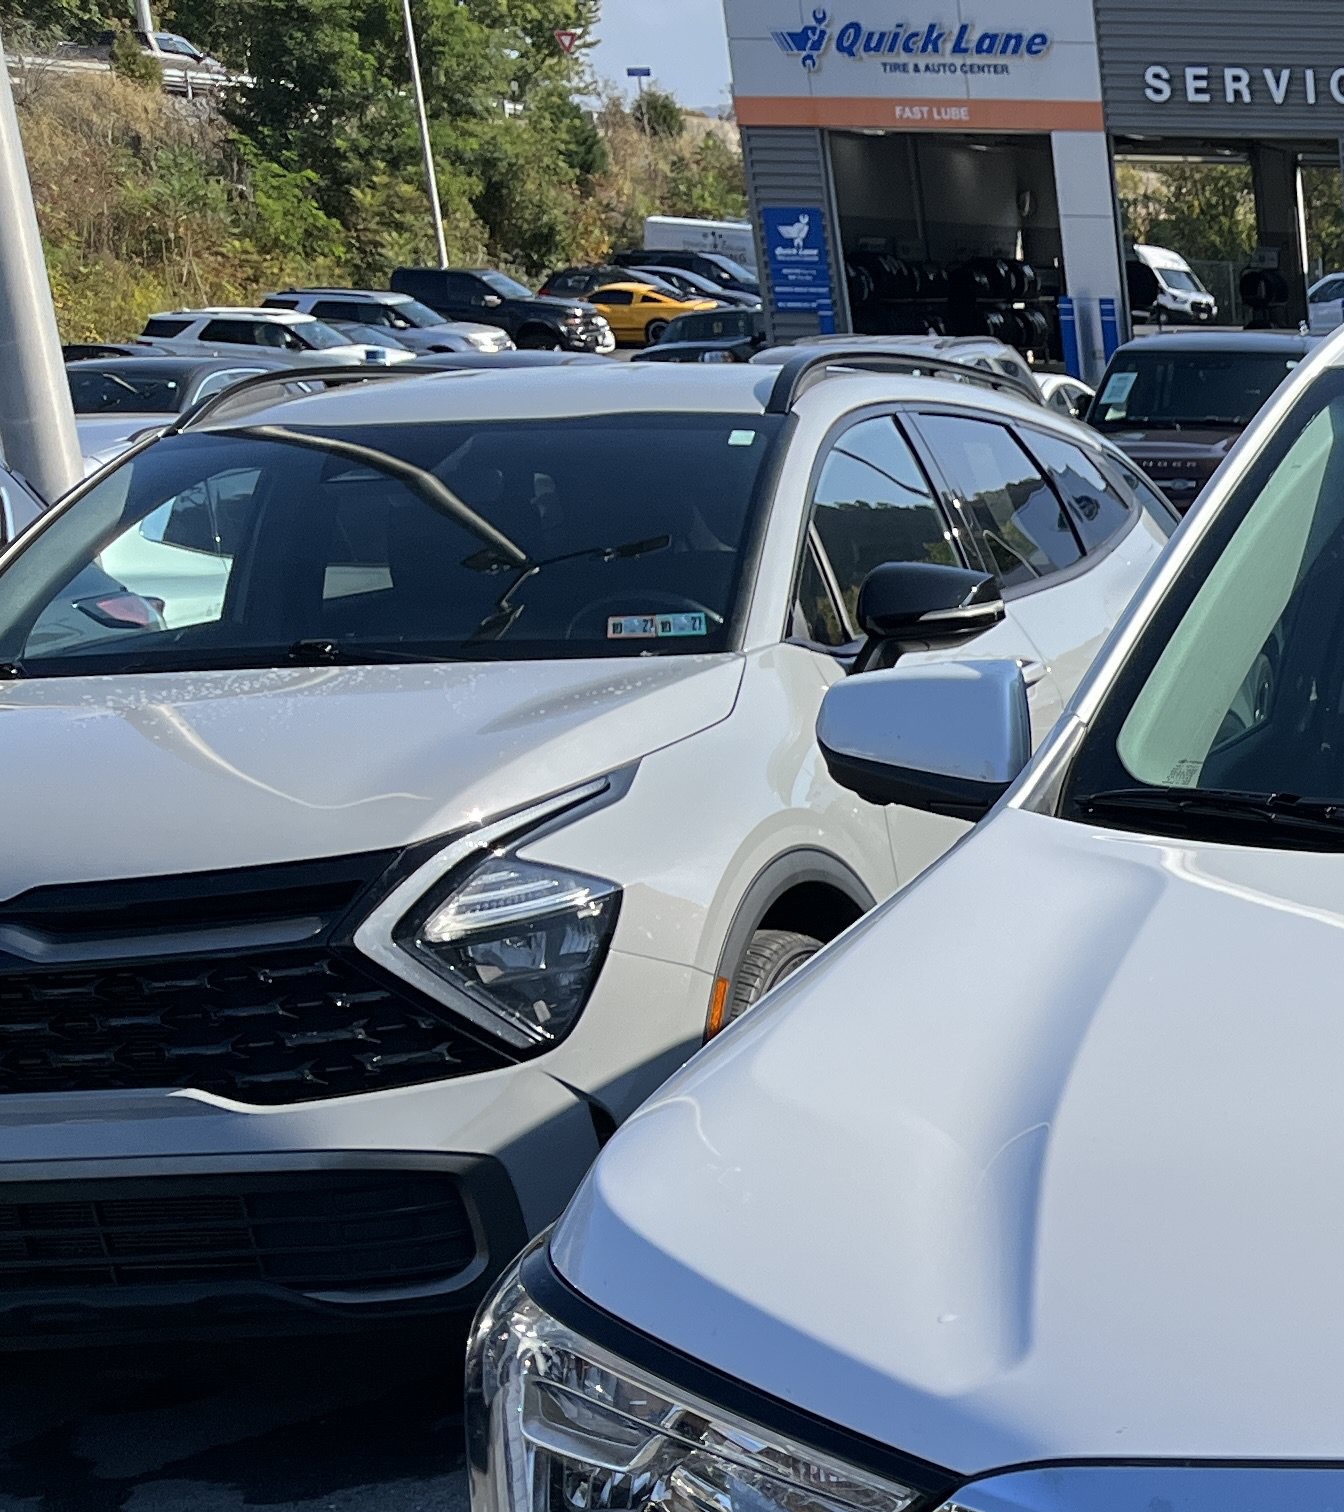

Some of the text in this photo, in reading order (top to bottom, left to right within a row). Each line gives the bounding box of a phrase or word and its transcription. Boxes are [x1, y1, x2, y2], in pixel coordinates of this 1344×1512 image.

[835, 21, 1048, 57] Quick Lane
[881, 62, 1010, 75] TIRE & AUTO CENTER
[895, 106, 969, 121] FAST LUBE
